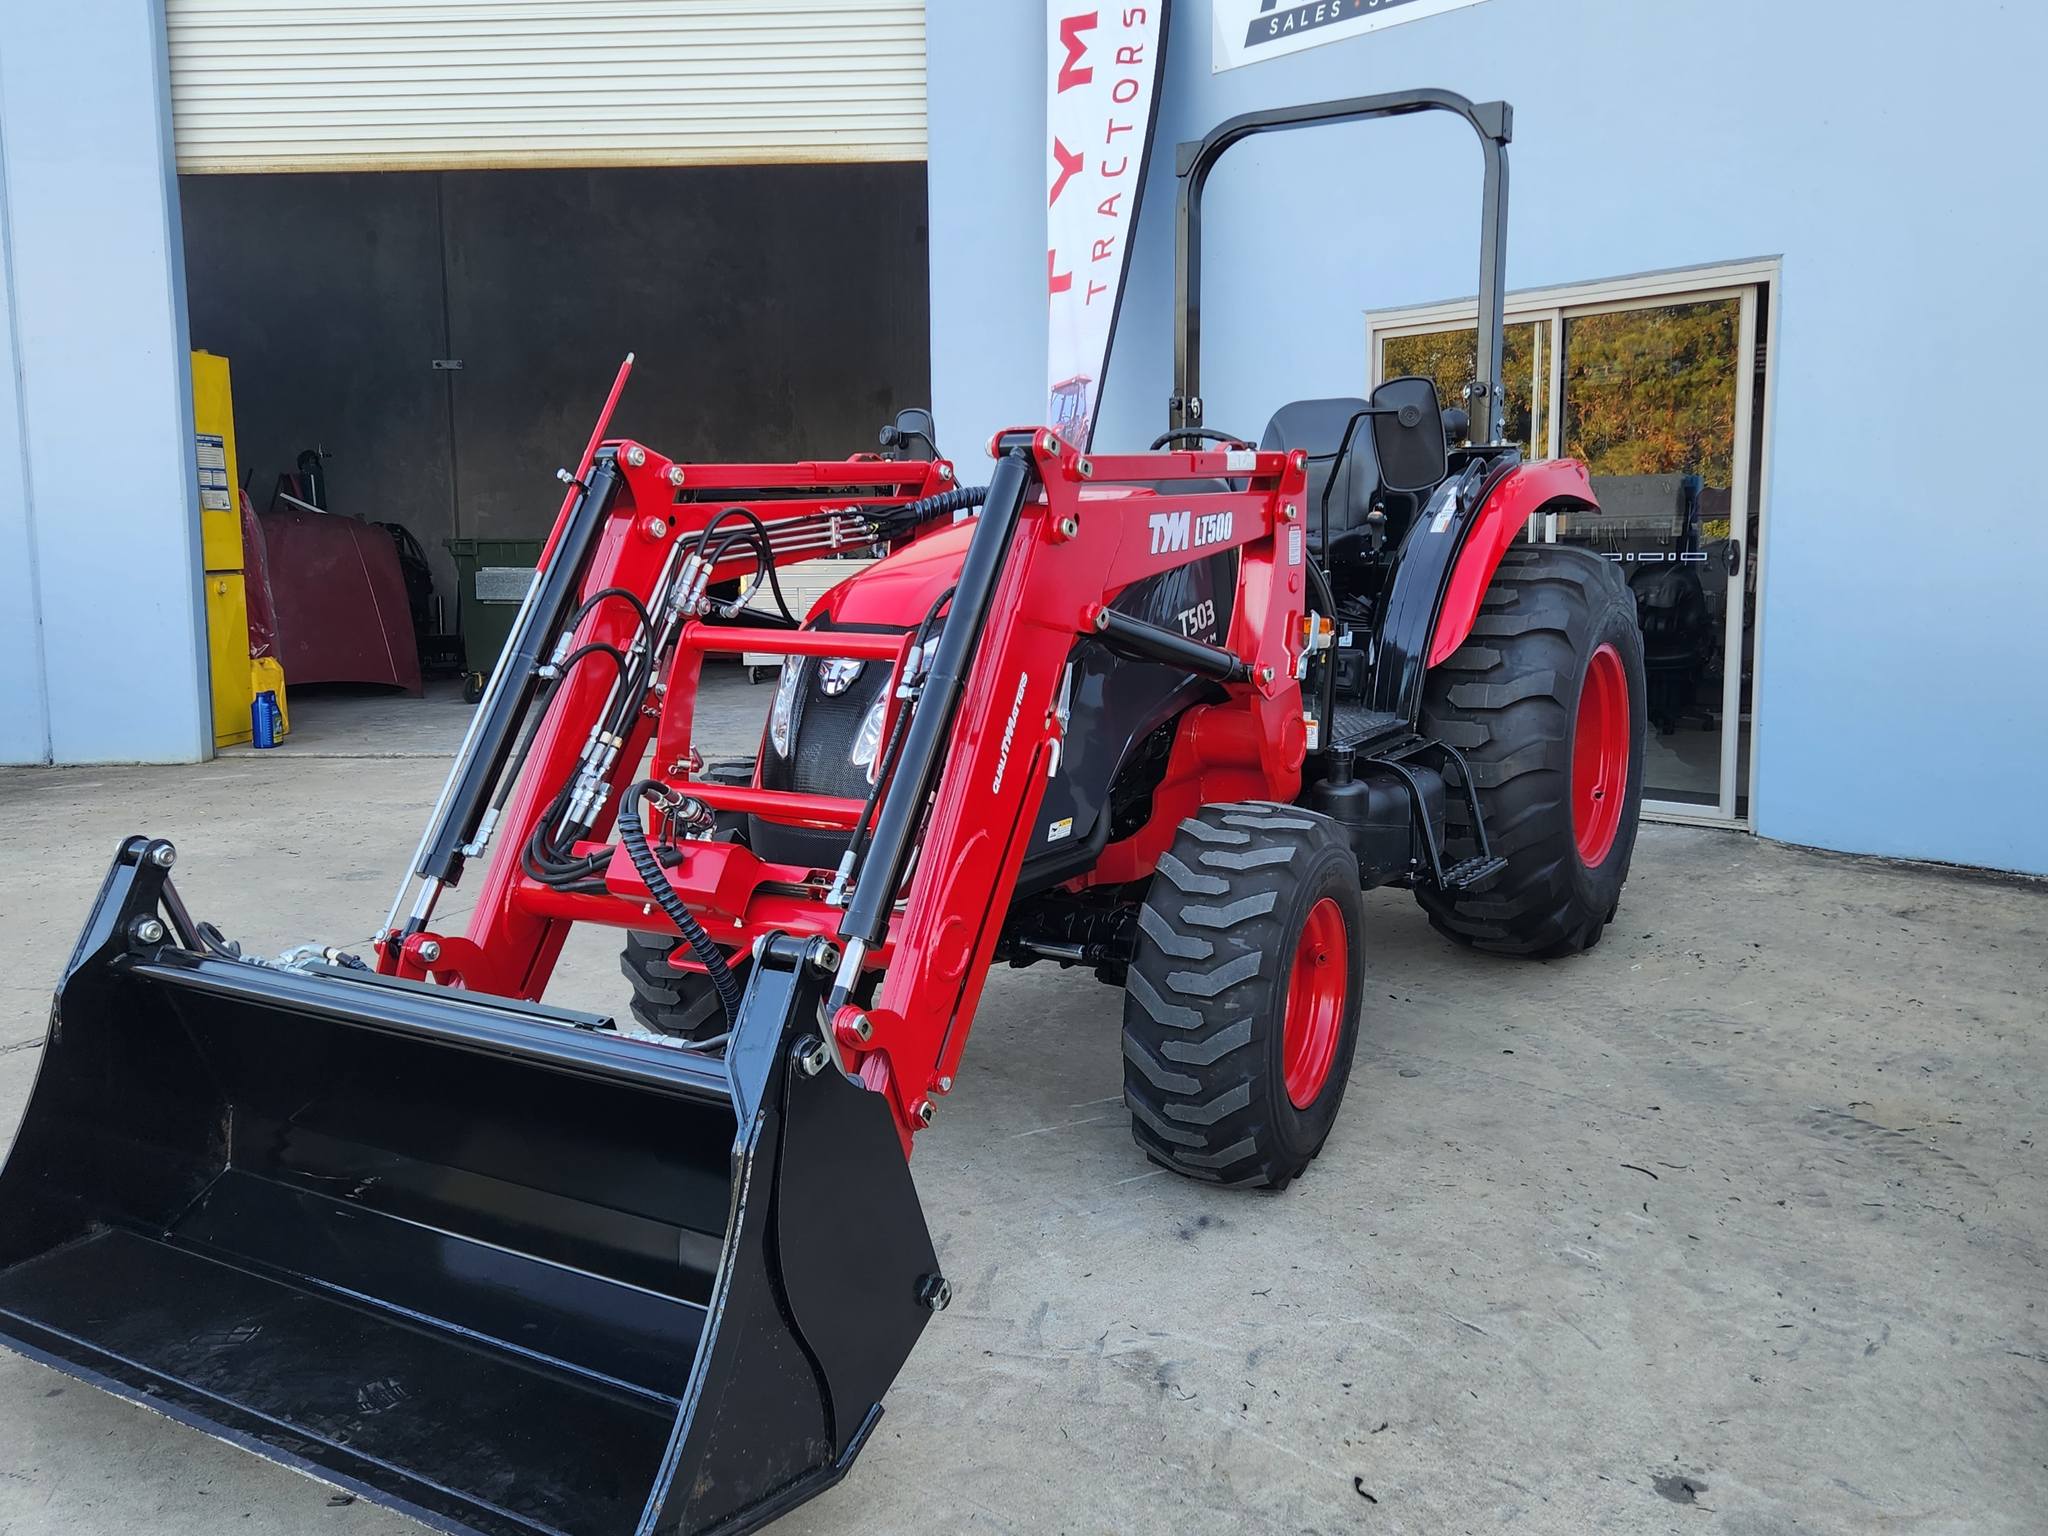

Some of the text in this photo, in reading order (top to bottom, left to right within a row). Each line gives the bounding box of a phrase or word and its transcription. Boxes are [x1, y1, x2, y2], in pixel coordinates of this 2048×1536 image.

[1269, 0, 1341, 36] SALES
[1048, 10, 1098, 307] TYM
[1085, 8, 1147, 306] TRACTORS
[1148, 511, 1233, 555] TYM LT500
[1178, 599, 1216, 637] T503
[1202, 632, 1217, 644] YM
